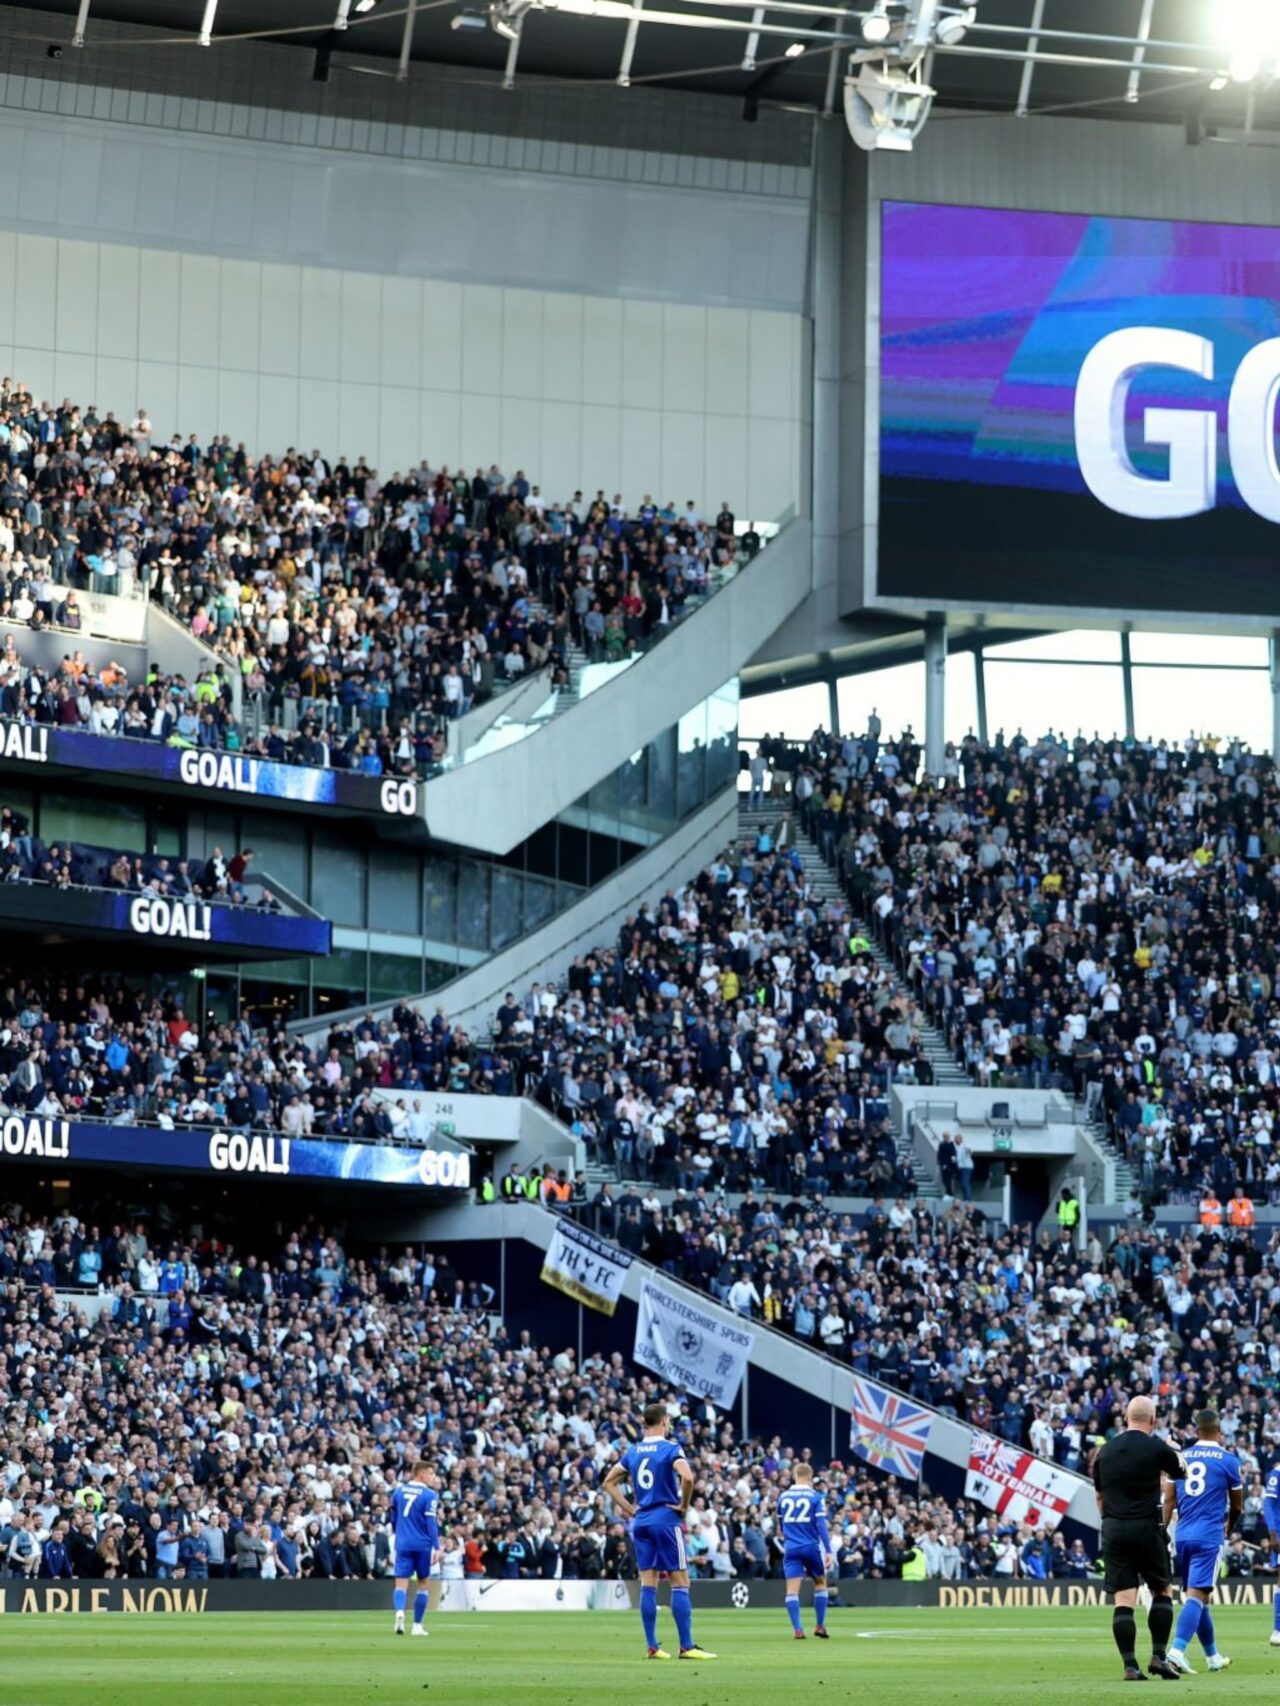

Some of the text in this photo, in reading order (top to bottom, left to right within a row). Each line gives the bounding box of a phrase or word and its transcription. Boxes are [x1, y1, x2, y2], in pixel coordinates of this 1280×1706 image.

[0, 722, 48, 762] AL!
[180, 750, 257, 794] GOAL!
[381, 780, 417, 815] GO
[130, 898, 212, 941] GOAL!
[0, 1116, 70, 1158] OAL!
[209, 1133, 290, 1174] GOAL!
[720, 1326, 752, 1347] SPURS
[637, 1457, 654, 1490] 6
[1182, 1450, 1223, 1460] ELEMANS
[979, 1460, 1057, 1509] TOTTENHAM
[1184, 1460, 1207, 1497] 8
[403, 1494, 418, 1518] 7
[781, 1497, 811, 1523] 22
